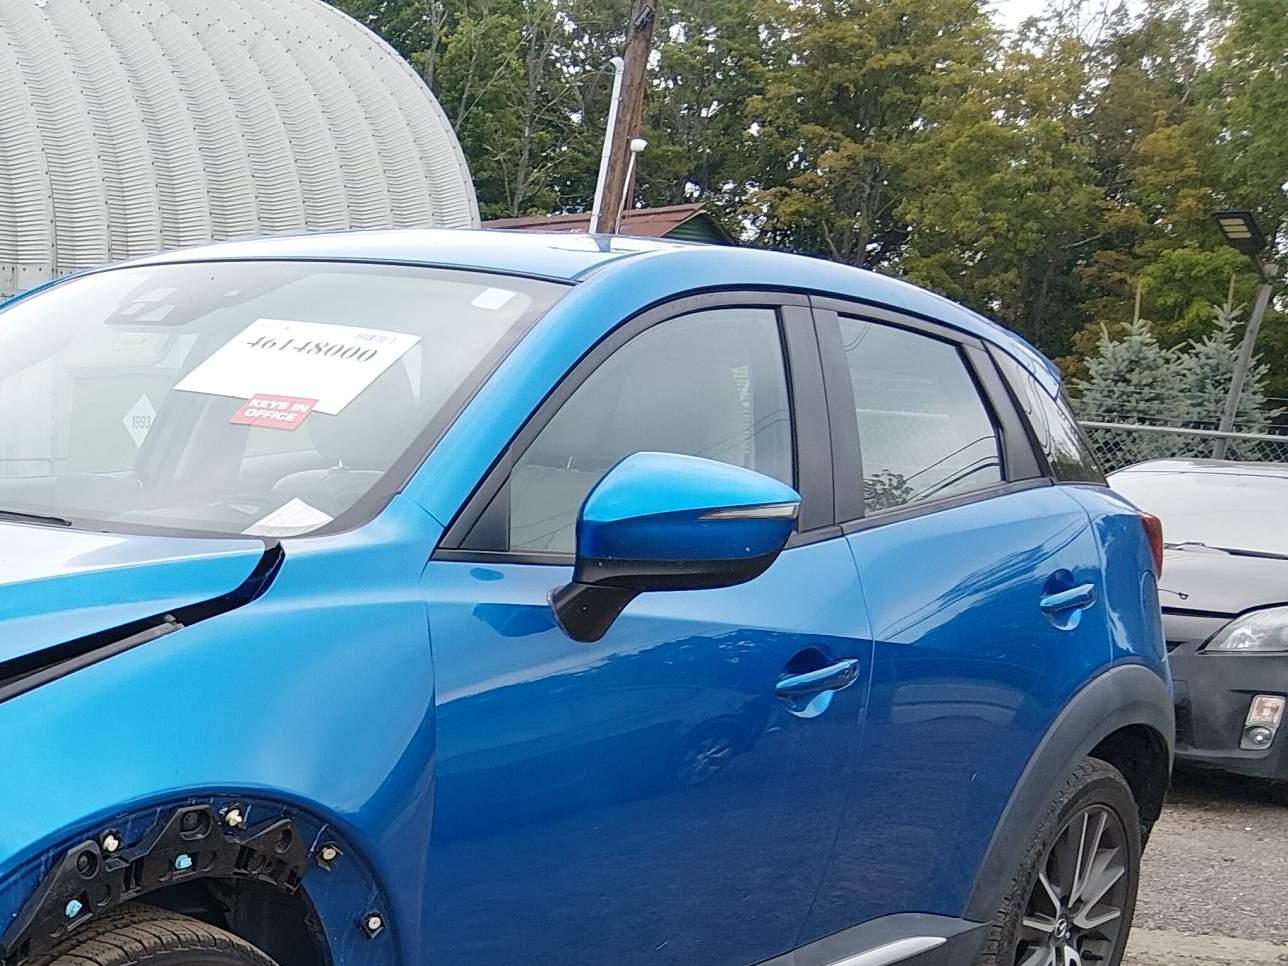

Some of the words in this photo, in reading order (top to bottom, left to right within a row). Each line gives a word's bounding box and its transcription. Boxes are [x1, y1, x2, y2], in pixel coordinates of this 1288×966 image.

[247, 336, 378, 362] 46148000
[248, 399, 289, 411] KEYS
[291, 403, 310, 412] IN
[244, 409, 298, 423] OFFICE
